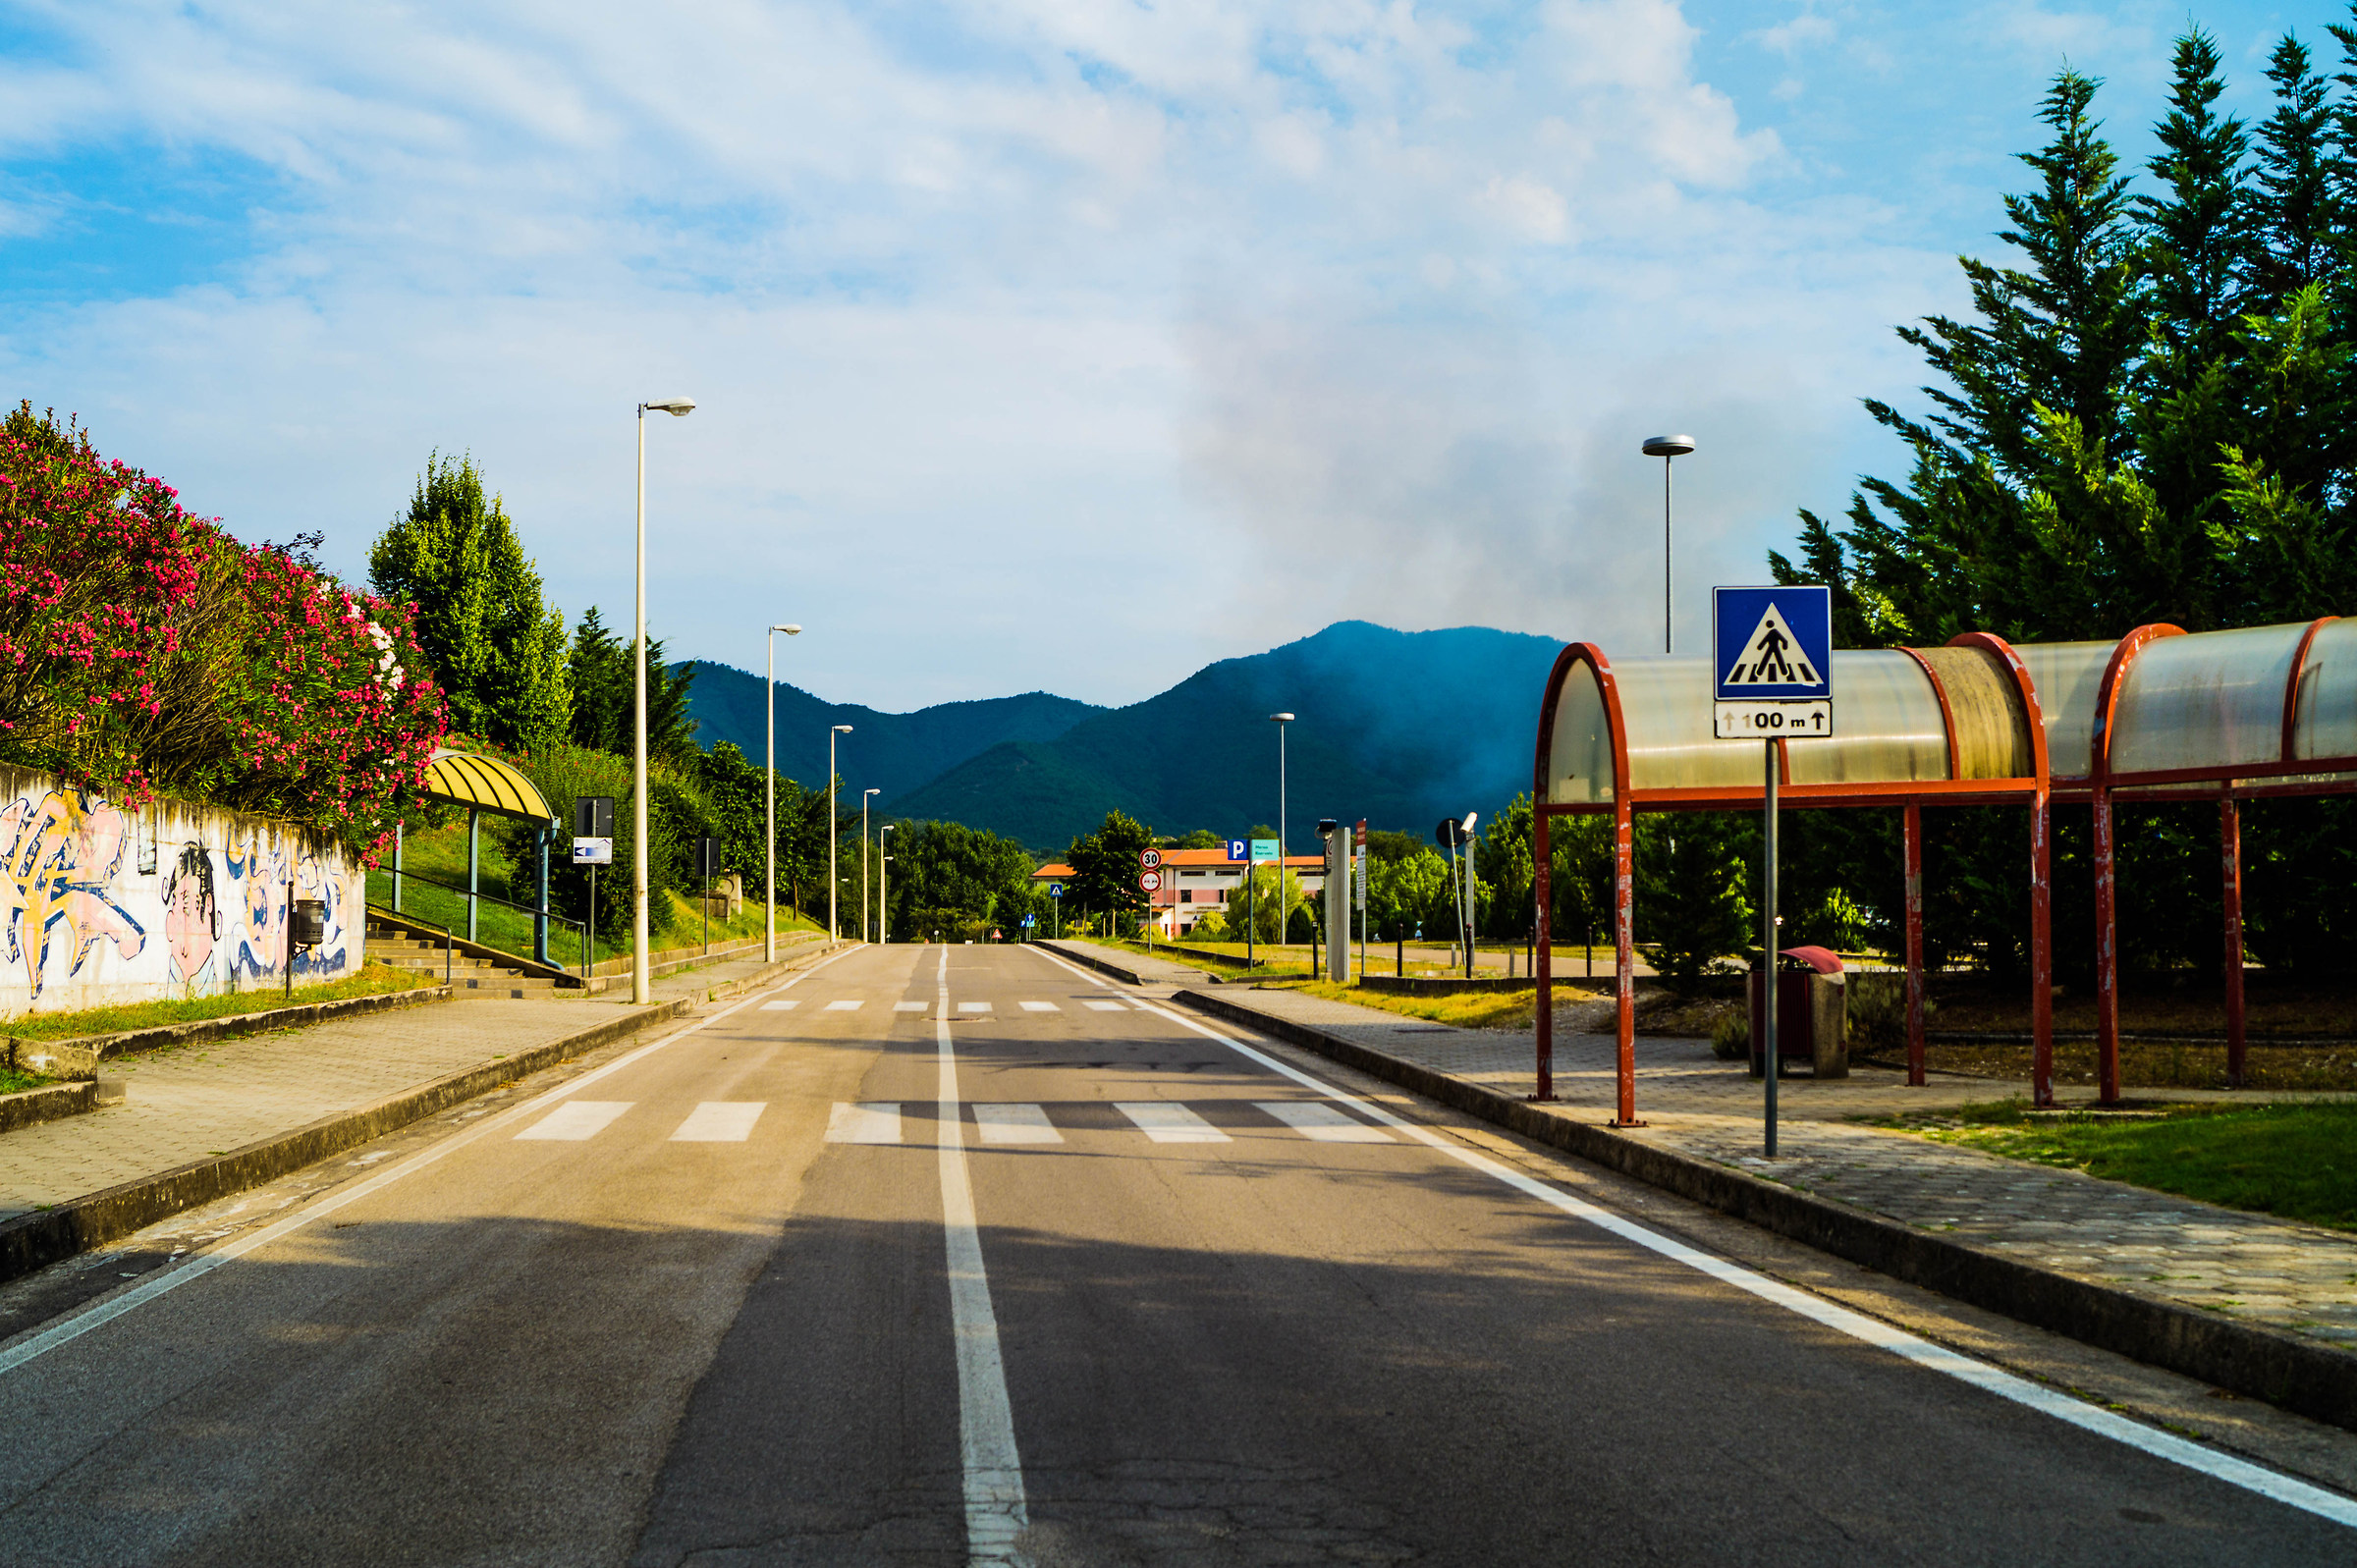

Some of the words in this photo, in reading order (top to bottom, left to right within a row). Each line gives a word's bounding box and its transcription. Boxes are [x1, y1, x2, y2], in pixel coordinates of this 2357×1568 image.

[1742, 712, 1783, 729] 100
[1790, 719, 1805, 728] m
[1233, 840, 1244, 859] P
[1144, 853, 1158, 864] 30
